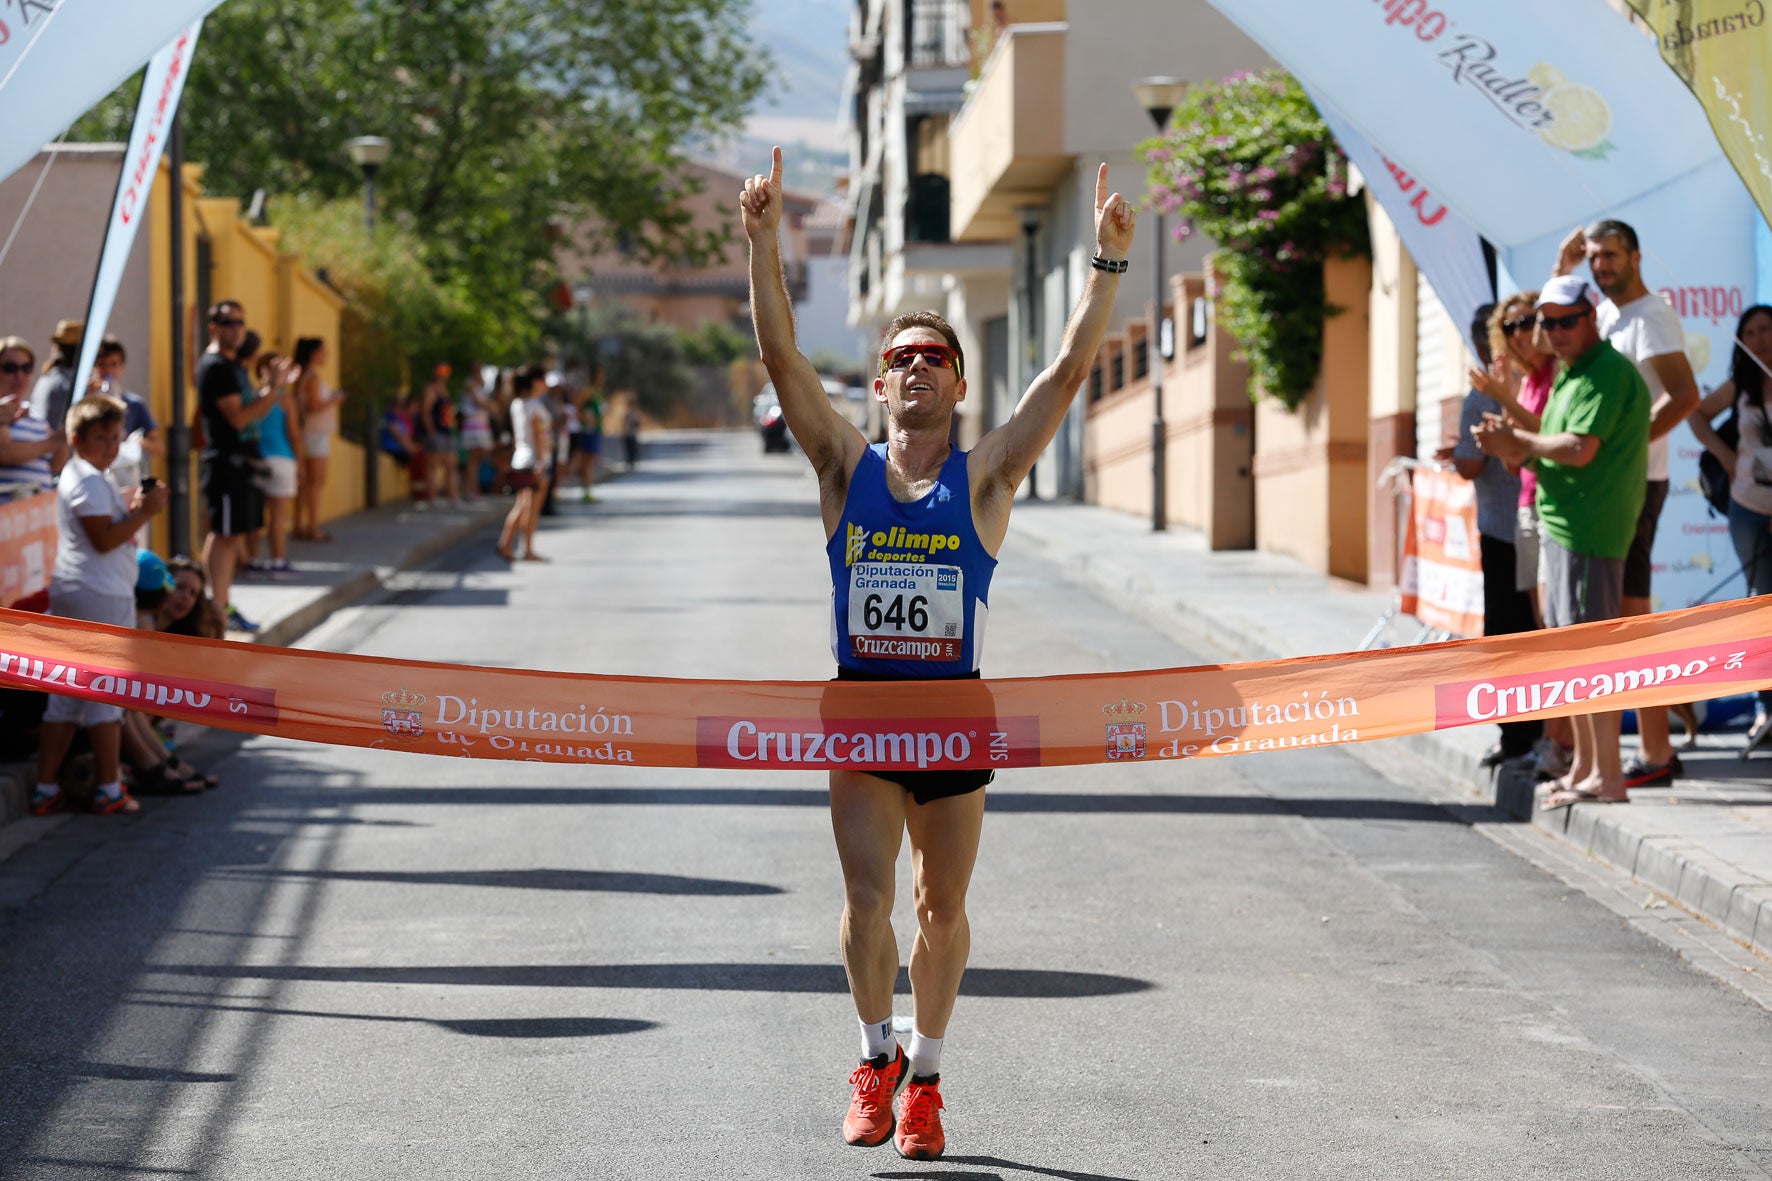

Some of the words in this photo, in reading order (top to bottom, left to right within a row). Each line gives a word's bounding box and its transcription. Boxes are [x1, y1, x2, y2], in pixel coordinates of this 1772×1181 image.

[1437, 34, 1554, 128] Radler
[868, 549, 925, 562] deportes
[872, 527, 960, 554] olimpo
[855, 565, 934, 577] Diputación
[856, 578, 916, 589] Granada
[938, 574, 956, 582] 2015
[864, 594, 929, 632] 646
[856, 636, 940, 659] Cruzcampo
[0, 652, 211, 706] ruzcampo
[1466, 659, 1709, 720] Cruzcampo
[435, 694, 634, 735] Diputación
[1157, 690, 1361, 736] Diputación
[727, 720, 971, 768] Cruzcampo
[989, 732, 1008, 761] SIN
[1159, 739, 1199, 758] de
[1211, 723, 1360, 754] Granada
